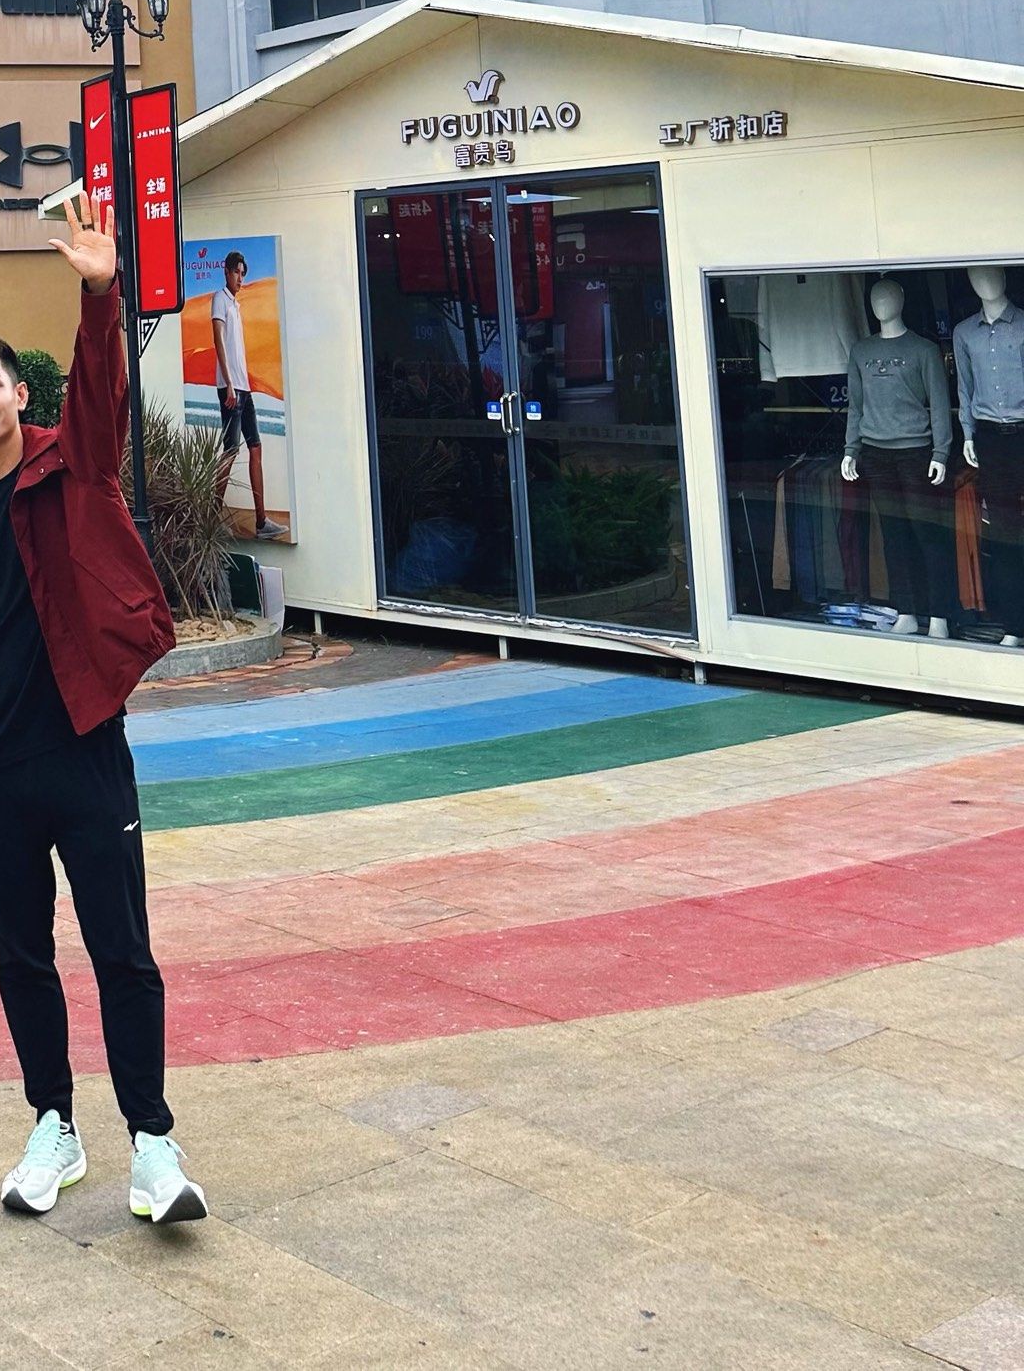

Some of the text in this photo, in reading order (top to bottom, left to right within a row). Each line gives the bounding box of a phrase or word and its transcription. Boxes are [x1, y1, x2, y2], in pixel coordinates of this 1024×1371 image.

[400, 101, 581, 143] FUGUINIAO
[659, 110, 789, 146] 工厂折扣店
[453, 140, 515, 170] 富贵鸟
[92, 162, 108, 180] 全场
[146, 177, 166, 195] 全场
[144, 201, 170, 220] 1折起
